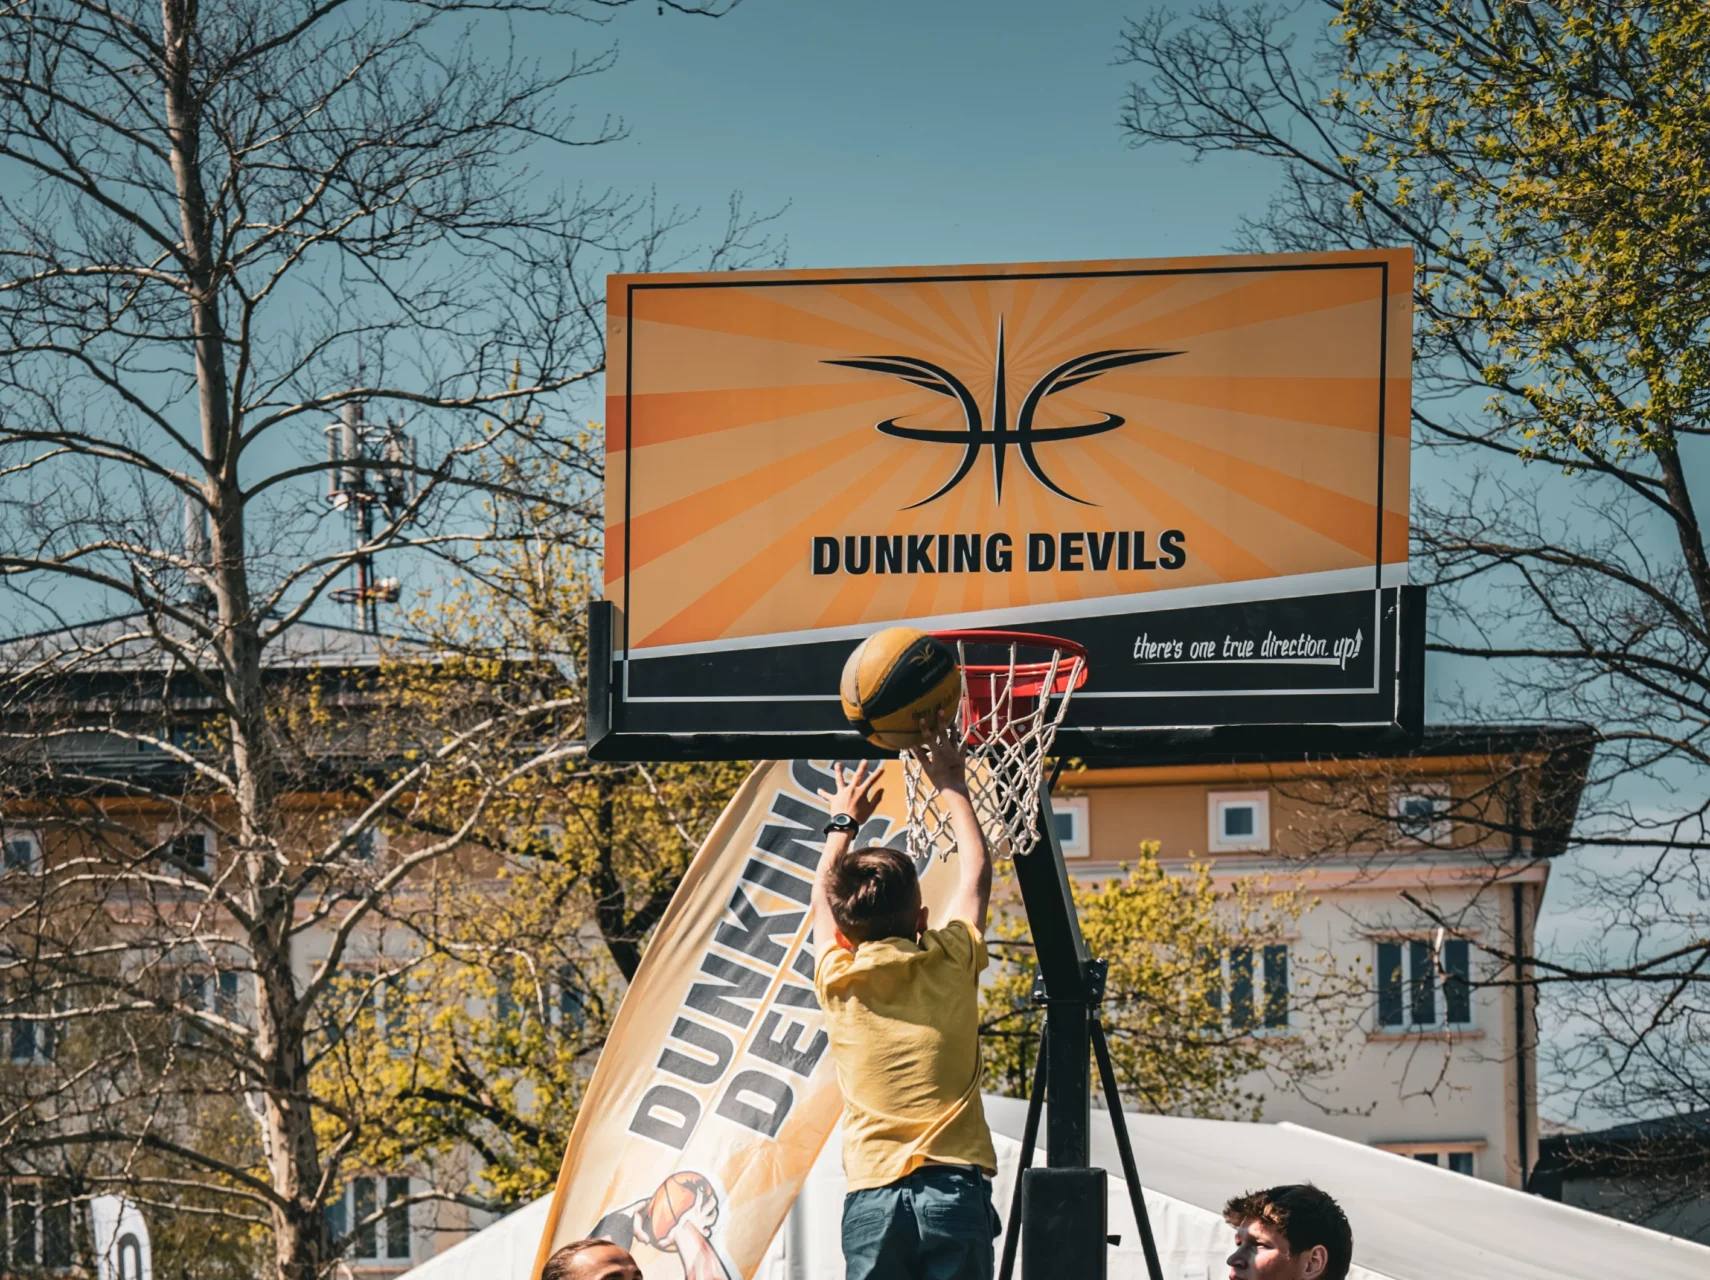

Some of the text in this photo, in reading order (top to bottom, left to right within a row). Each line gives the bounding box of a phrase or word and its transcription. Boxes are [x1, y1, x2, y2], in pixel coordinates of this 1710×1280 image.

[811, 529, 1186, 575] DUNKING DEVILS
[1133, 632, 1182, 660] there's
[1189, 640, 1216, 660] one
[1222, 634, 1254, 659] true
[629, 759, 884, 1152] DUNKING
